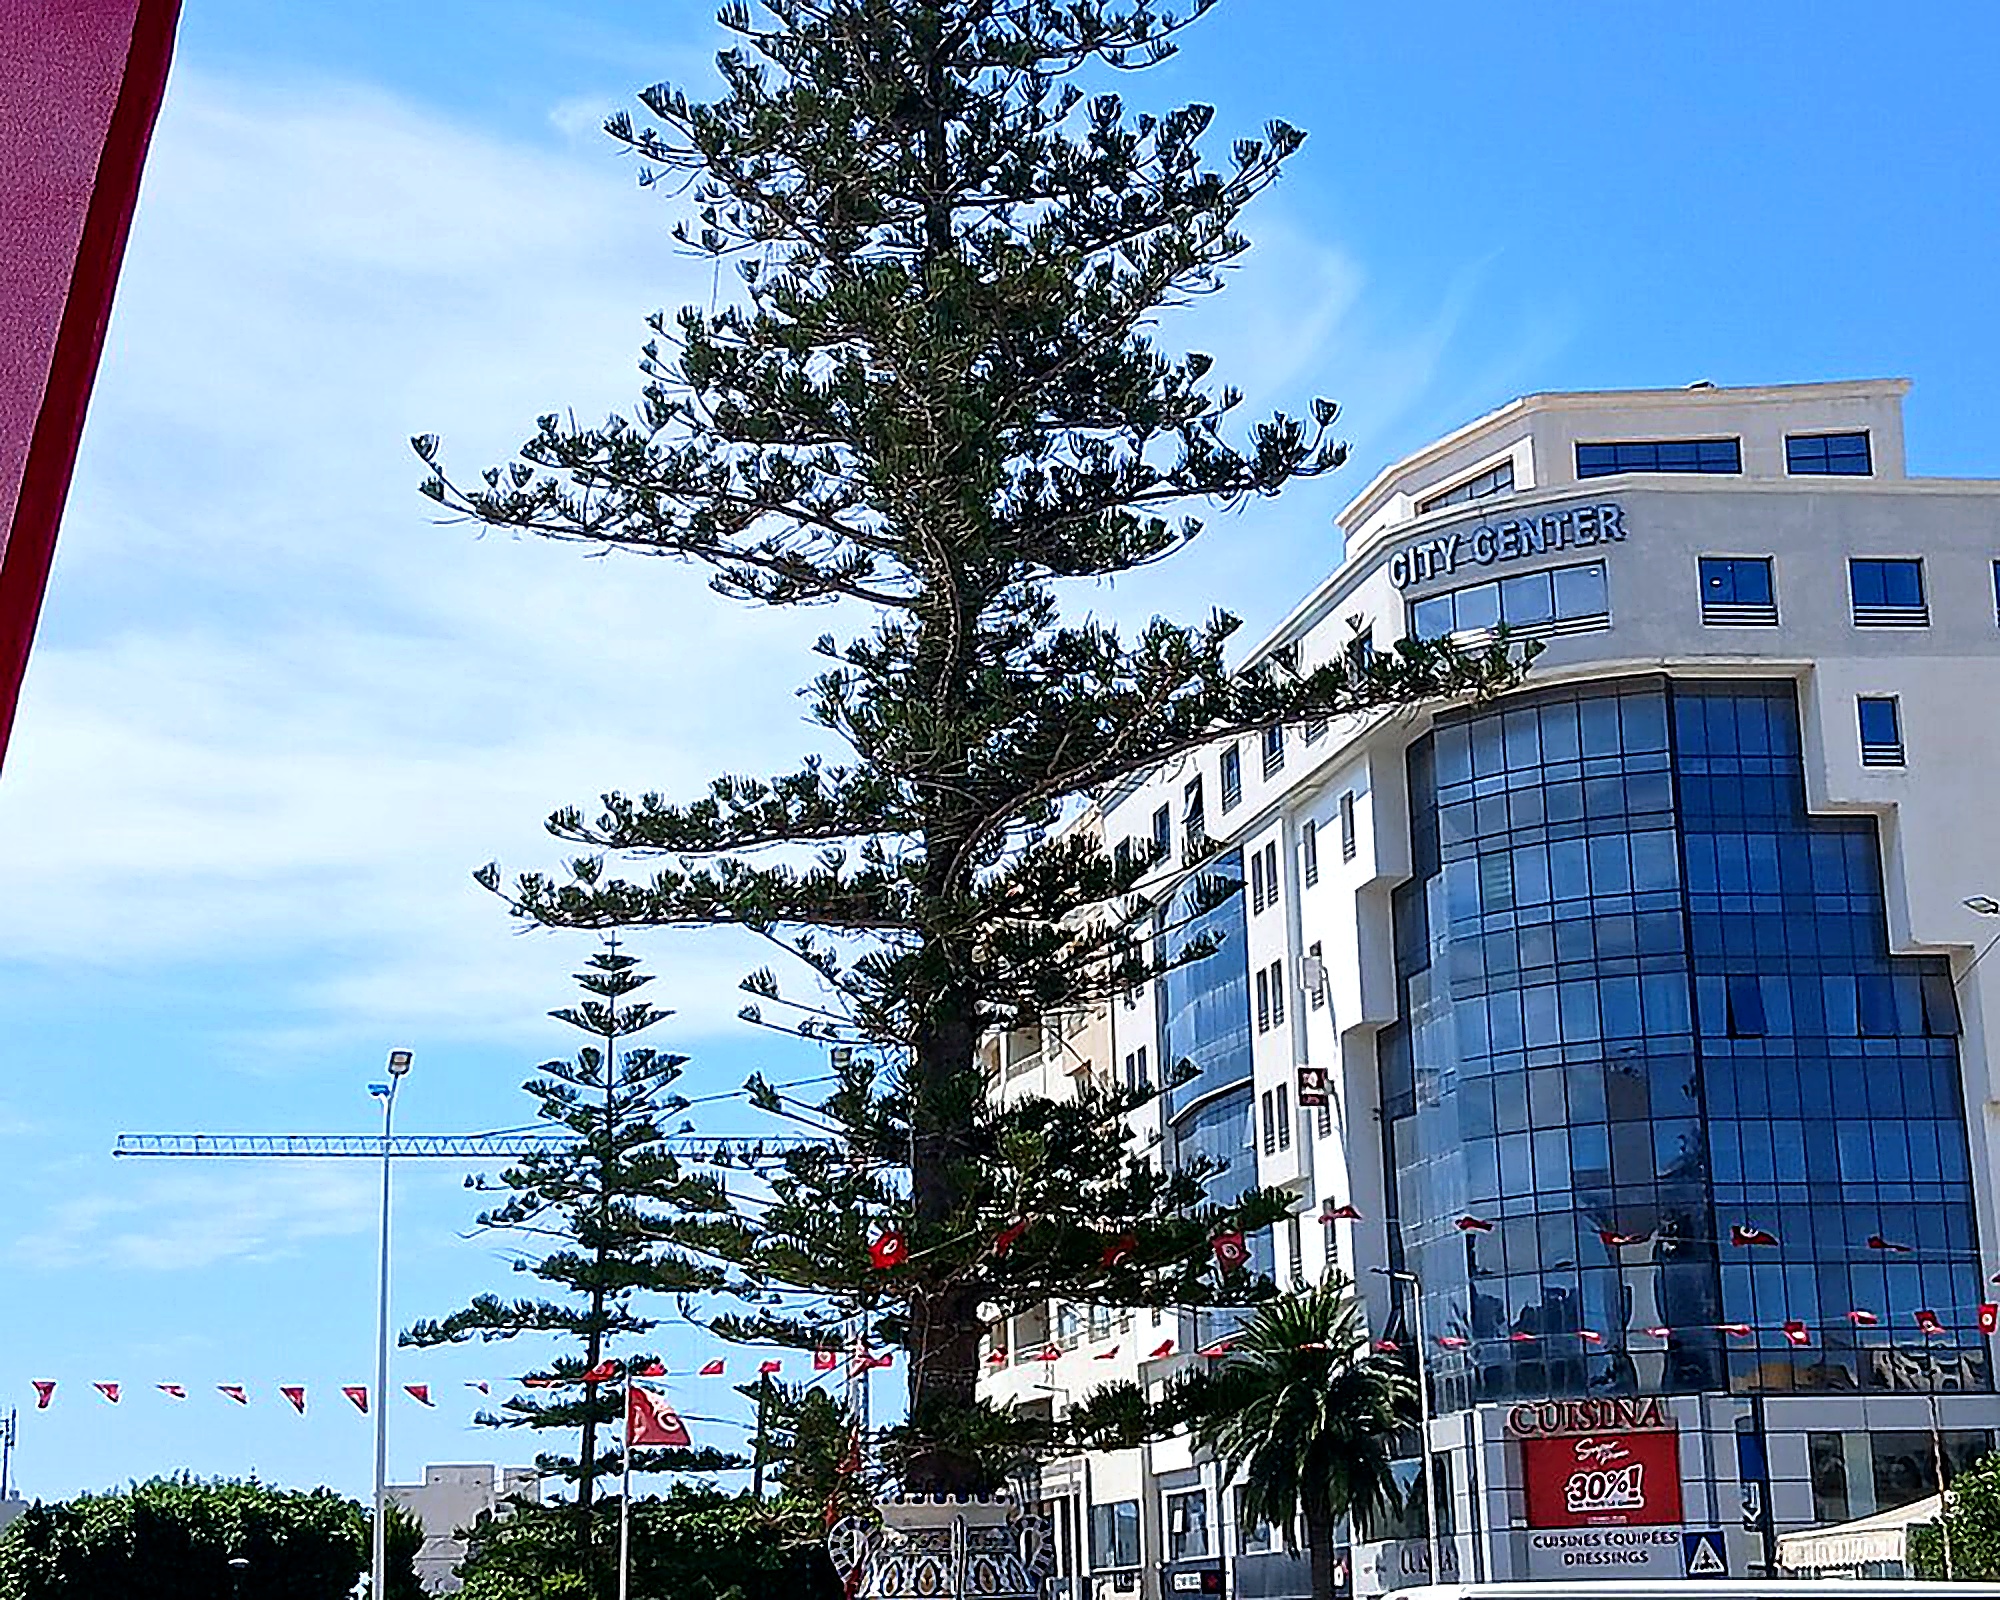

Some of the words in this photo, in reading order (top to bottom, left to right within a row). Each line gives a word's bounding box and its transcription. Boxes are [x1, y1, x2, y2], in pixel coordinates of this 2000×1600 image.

[1389, 533, 1460, 590] CITY
[1472, 503, 1628, 566] CENTER
[1508, 1397, 1665, 1434] CUISINA
